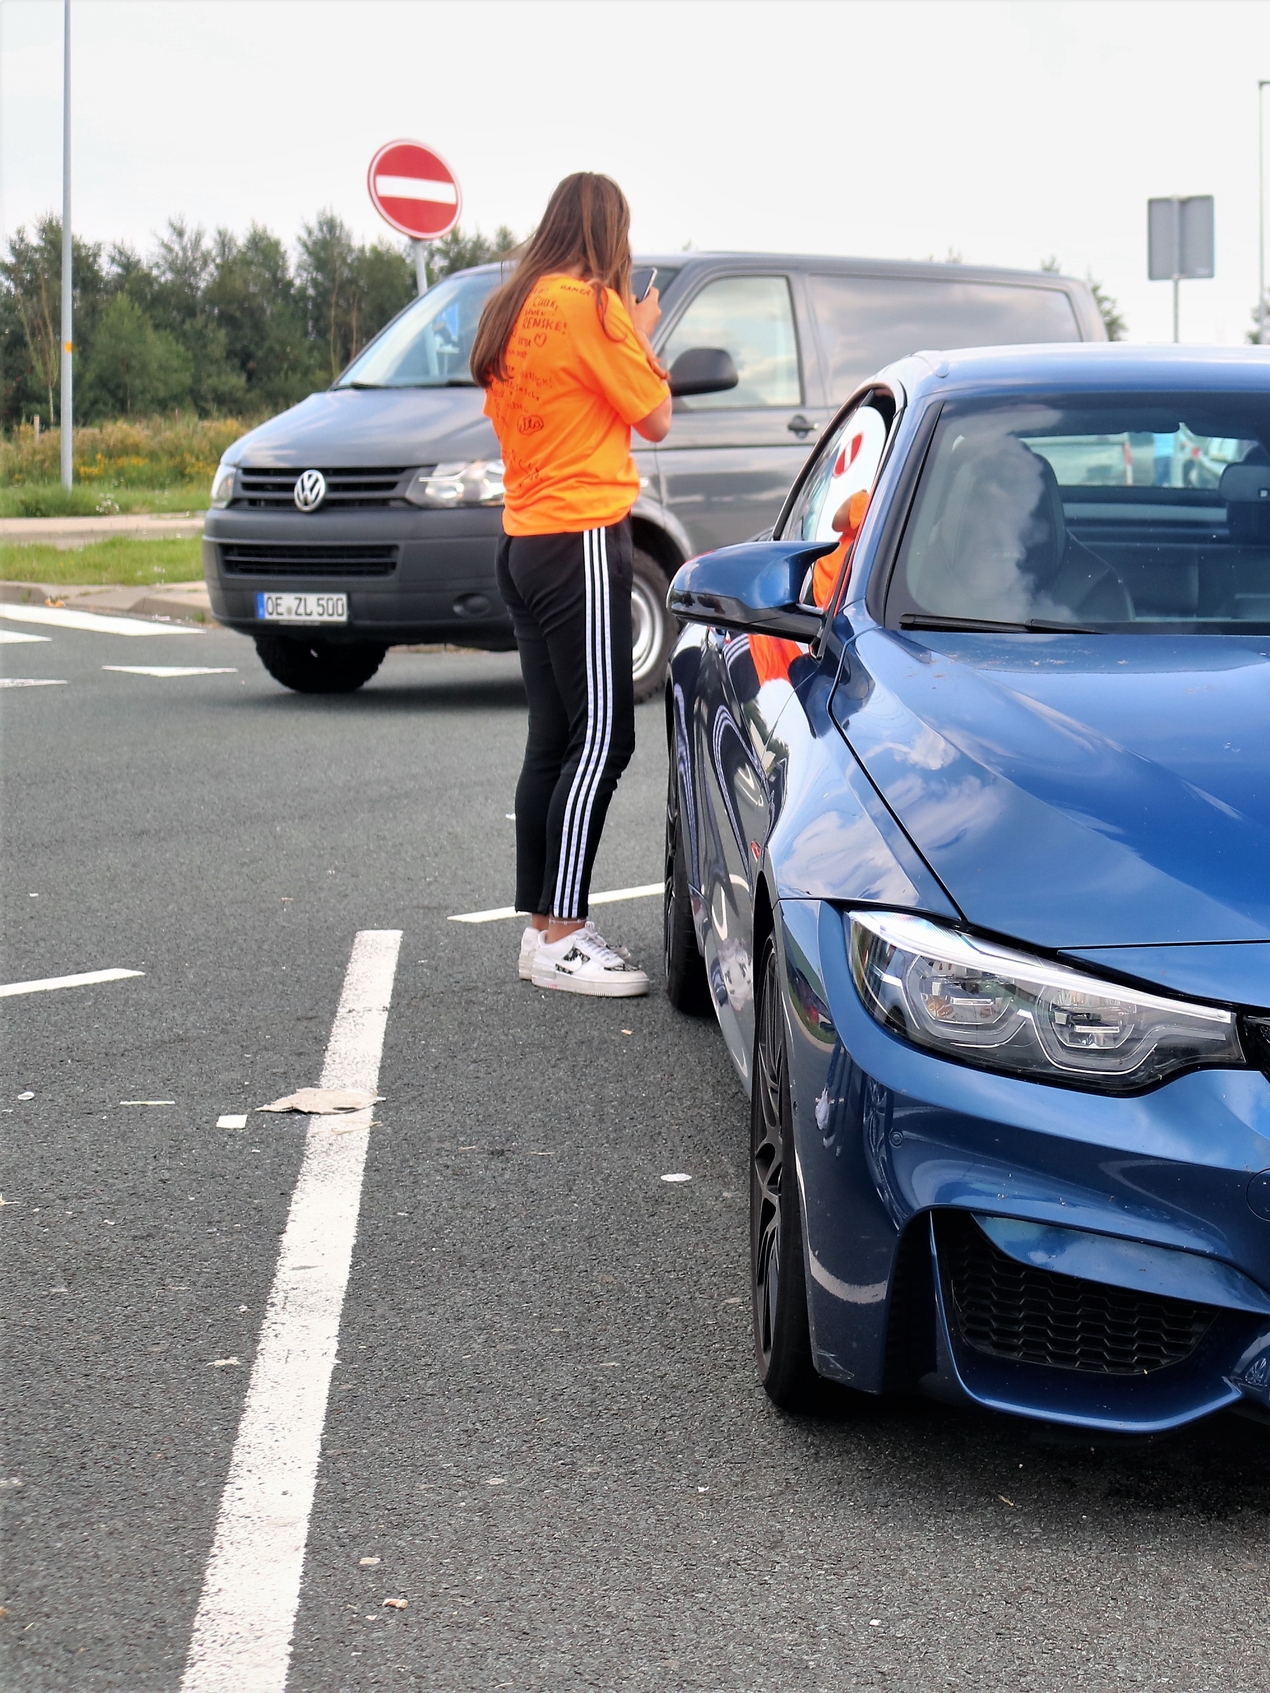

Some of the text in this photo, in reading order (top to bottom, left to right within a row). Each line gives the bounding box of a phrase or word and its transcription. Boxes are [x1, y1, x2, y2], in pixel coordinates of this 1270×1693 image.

[266, 596, 284, 616] OE
[294, 597, 313, 616] ZL
[317, 597, 345, 617] 500
